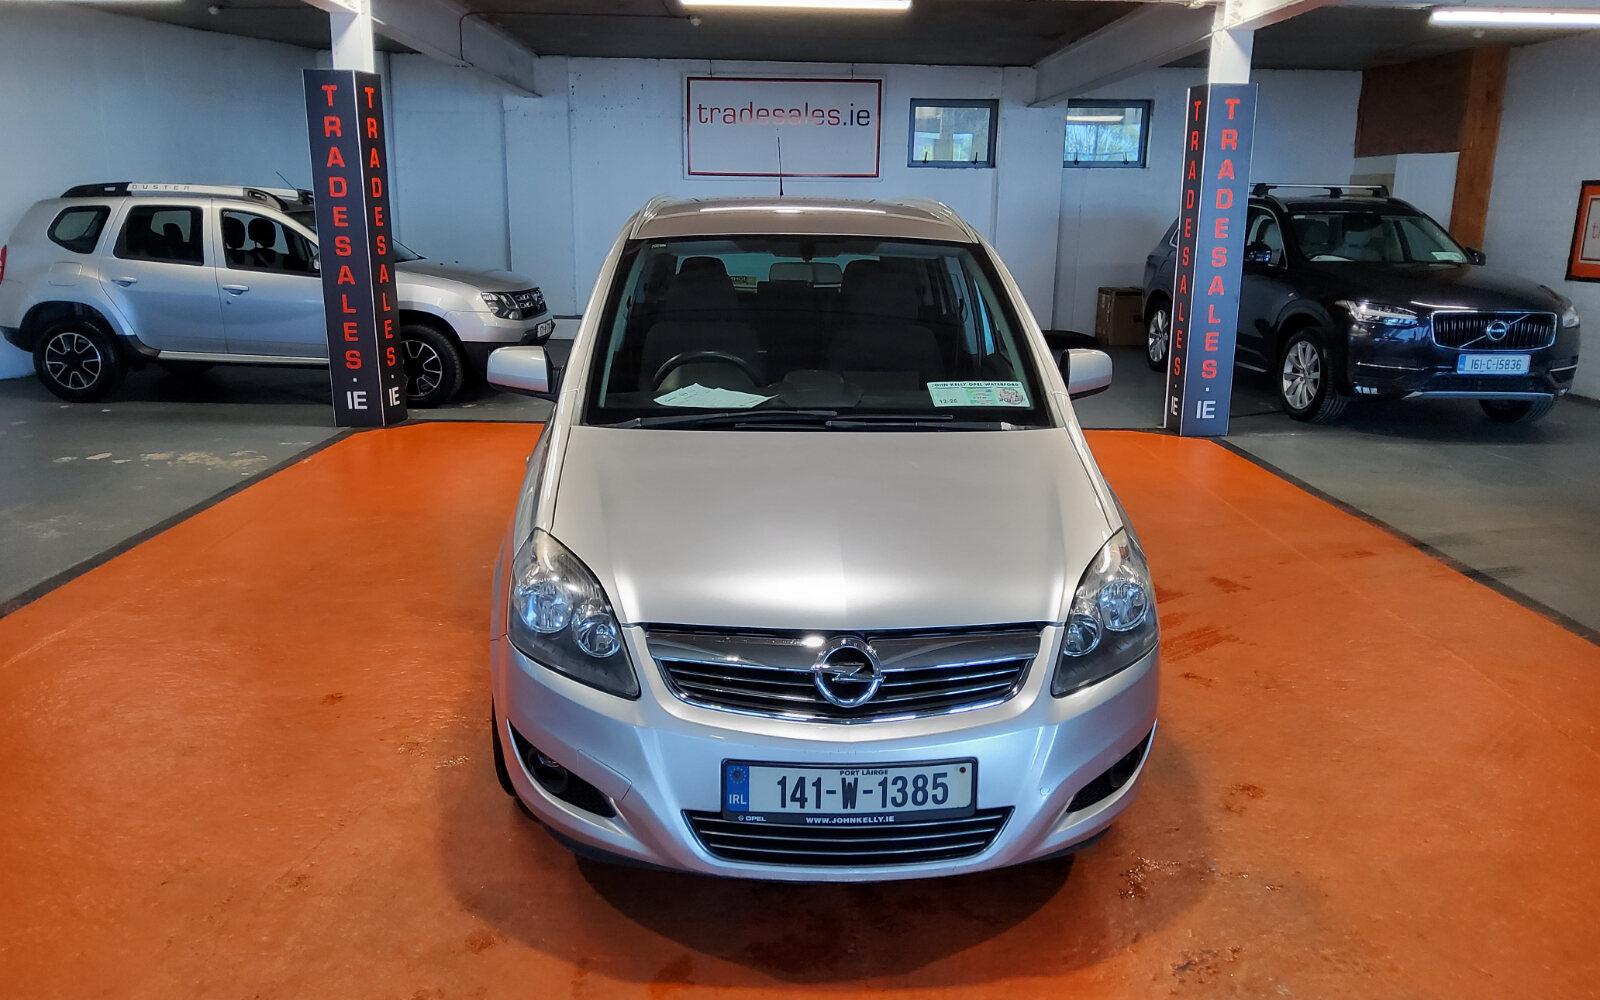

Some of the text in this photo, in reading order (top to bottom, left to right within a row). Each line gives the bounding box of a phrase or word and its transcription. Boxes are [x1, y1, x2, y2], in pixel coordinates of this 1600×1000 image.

[696, 101, 871, 126] tradesales.ie
[1470, 359, 1522, 370] 161-C-15836
[777, 772, 949, 809] 141-W-1385
[728, 794, 748, 805] IRL
[805, 815, 895, 824] WWW.JOHNKELLY.IE
